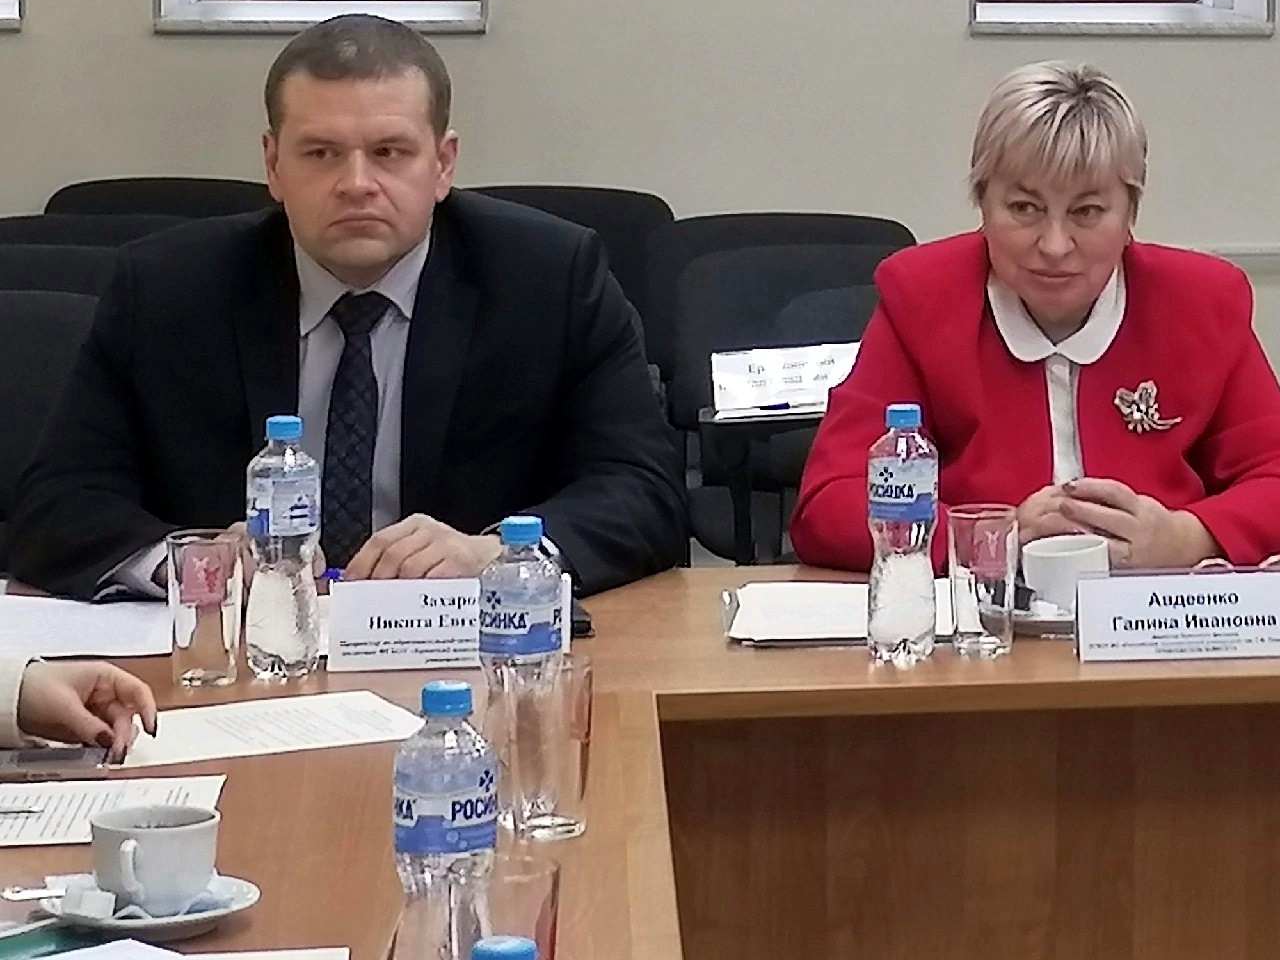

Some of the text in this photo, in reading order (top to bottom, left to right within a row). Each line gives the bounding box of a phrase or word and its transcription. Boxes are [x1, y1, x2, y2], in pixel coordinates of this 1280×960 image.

[1148, 592, 1239, 609] Авдеенко
[369, 615, 432, 630] Никита
[1112, 614, 1277, 632] Галина Ивановна
